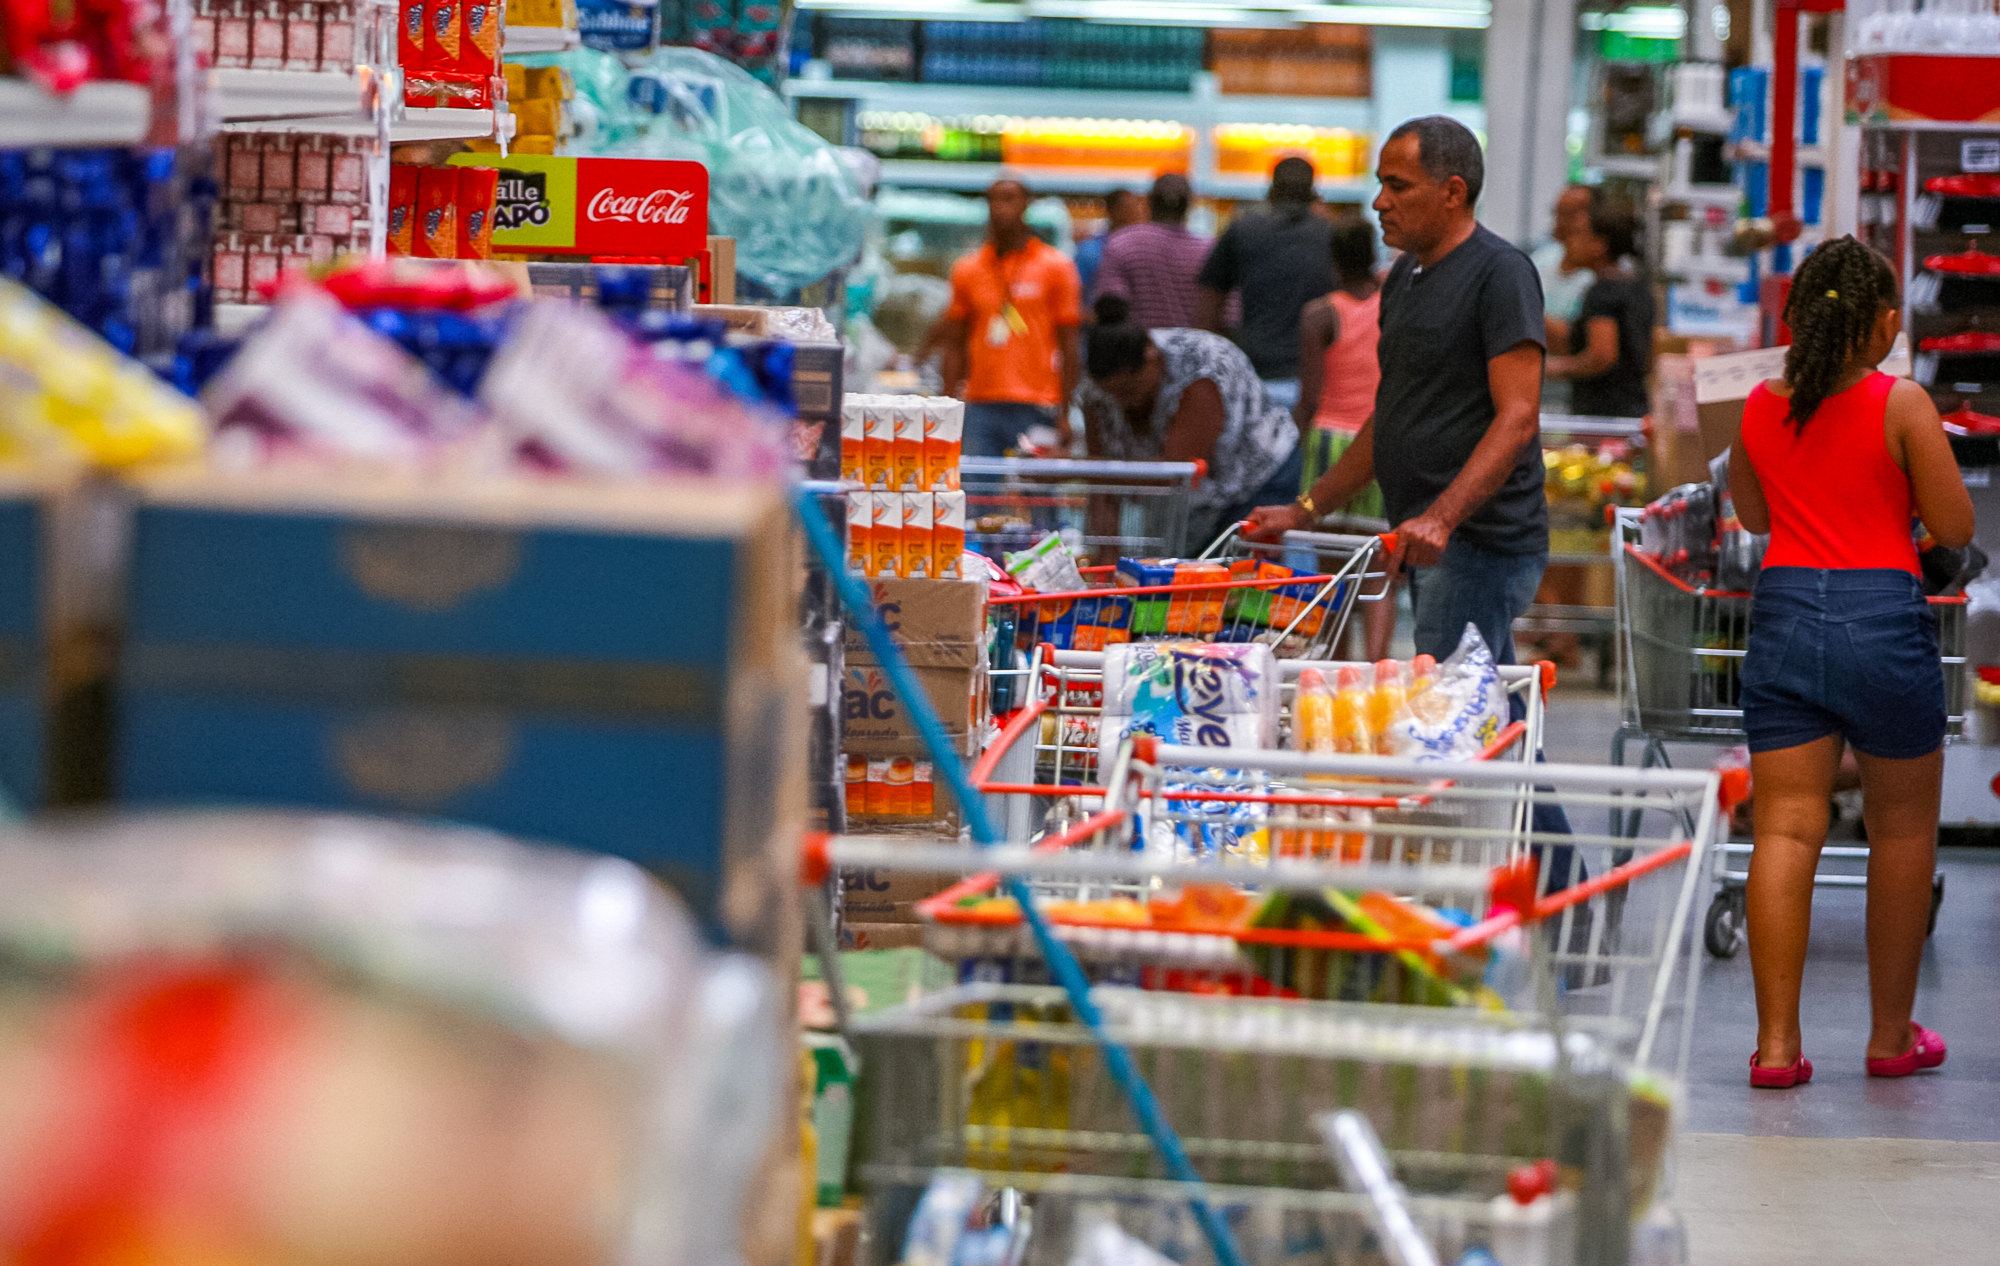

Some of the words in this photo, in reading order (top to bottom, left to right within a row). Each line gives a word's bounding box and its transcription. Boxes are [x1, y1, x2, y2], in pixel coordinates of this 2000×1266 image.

[496, 179, 540, 201] alle
[587, 187, 695, 224] Coca-Cola
[493, 201, 551, 234] APO
[845, 690, 896, 720] ac
[1169, 650, 1243, 747] Leve
[843, 866, 891, 893] ac
